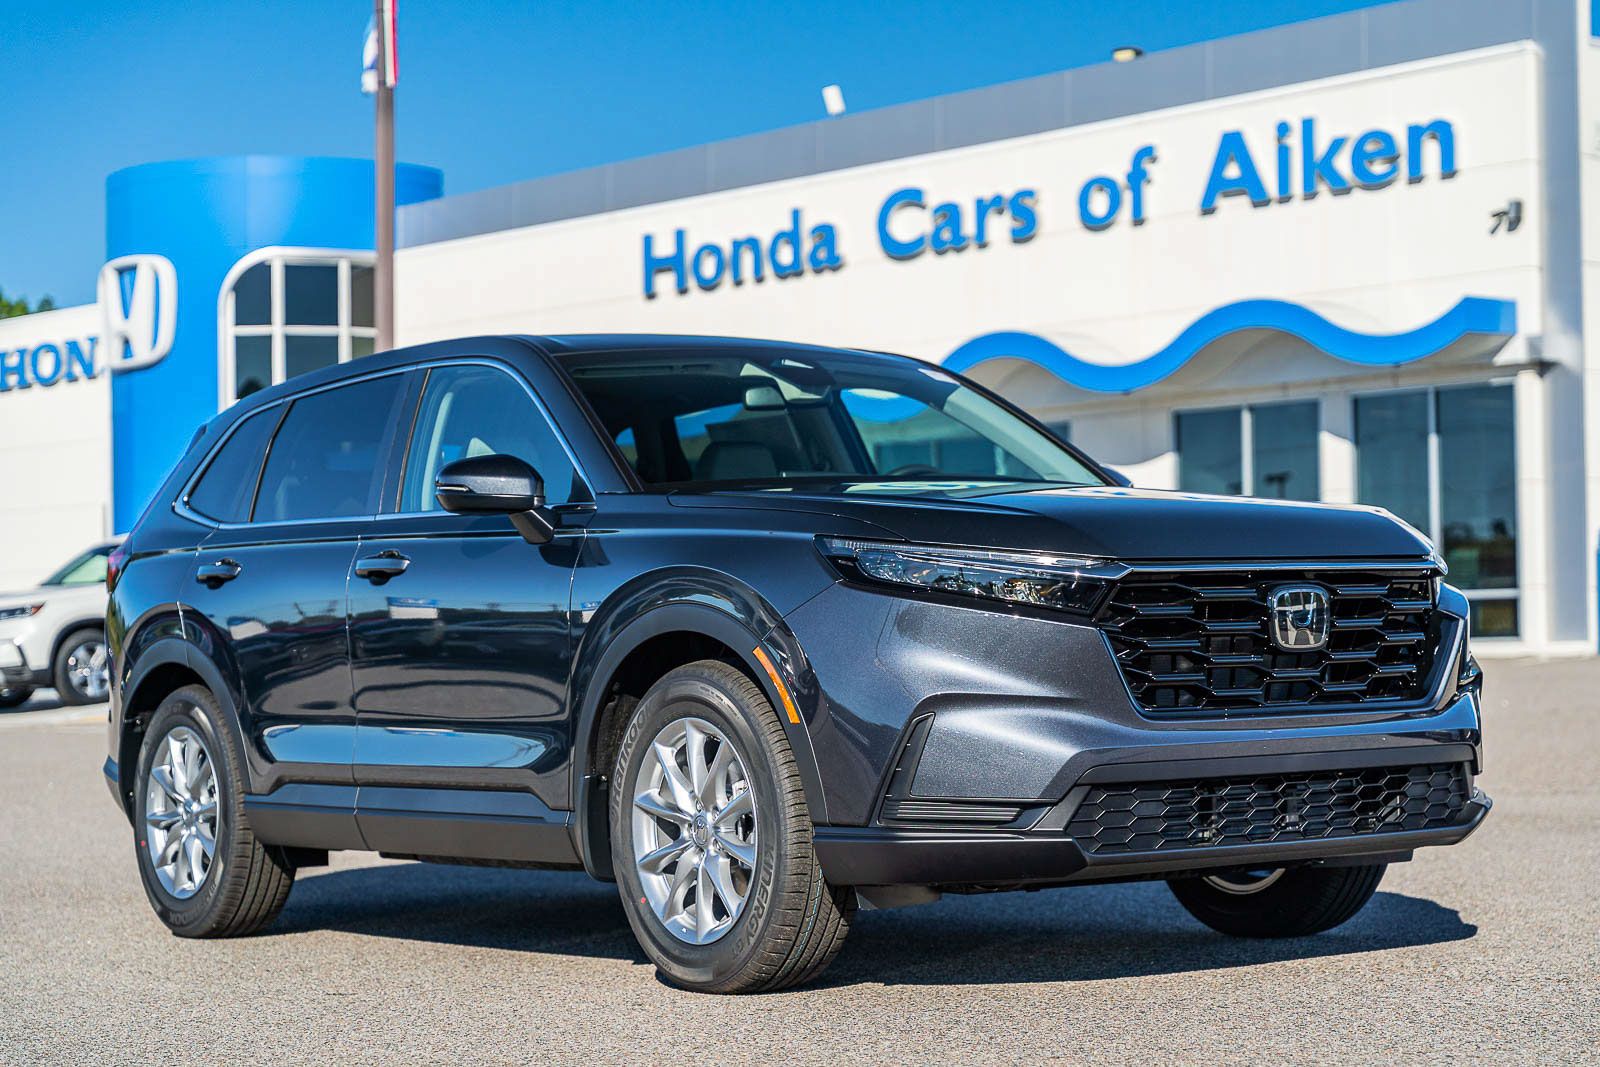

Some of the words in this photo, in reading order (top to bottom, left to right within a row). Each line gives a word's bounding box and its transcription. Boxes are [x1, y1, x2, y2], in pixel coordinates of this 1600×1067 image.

[643, 208, 842, 299] Honda
[877, 188, 1037, 260] Cars
[1079, 146, 1157, 231] of
[1200, 118, 1457, 215] Aiken
[0, 336, 103, 391] HON
